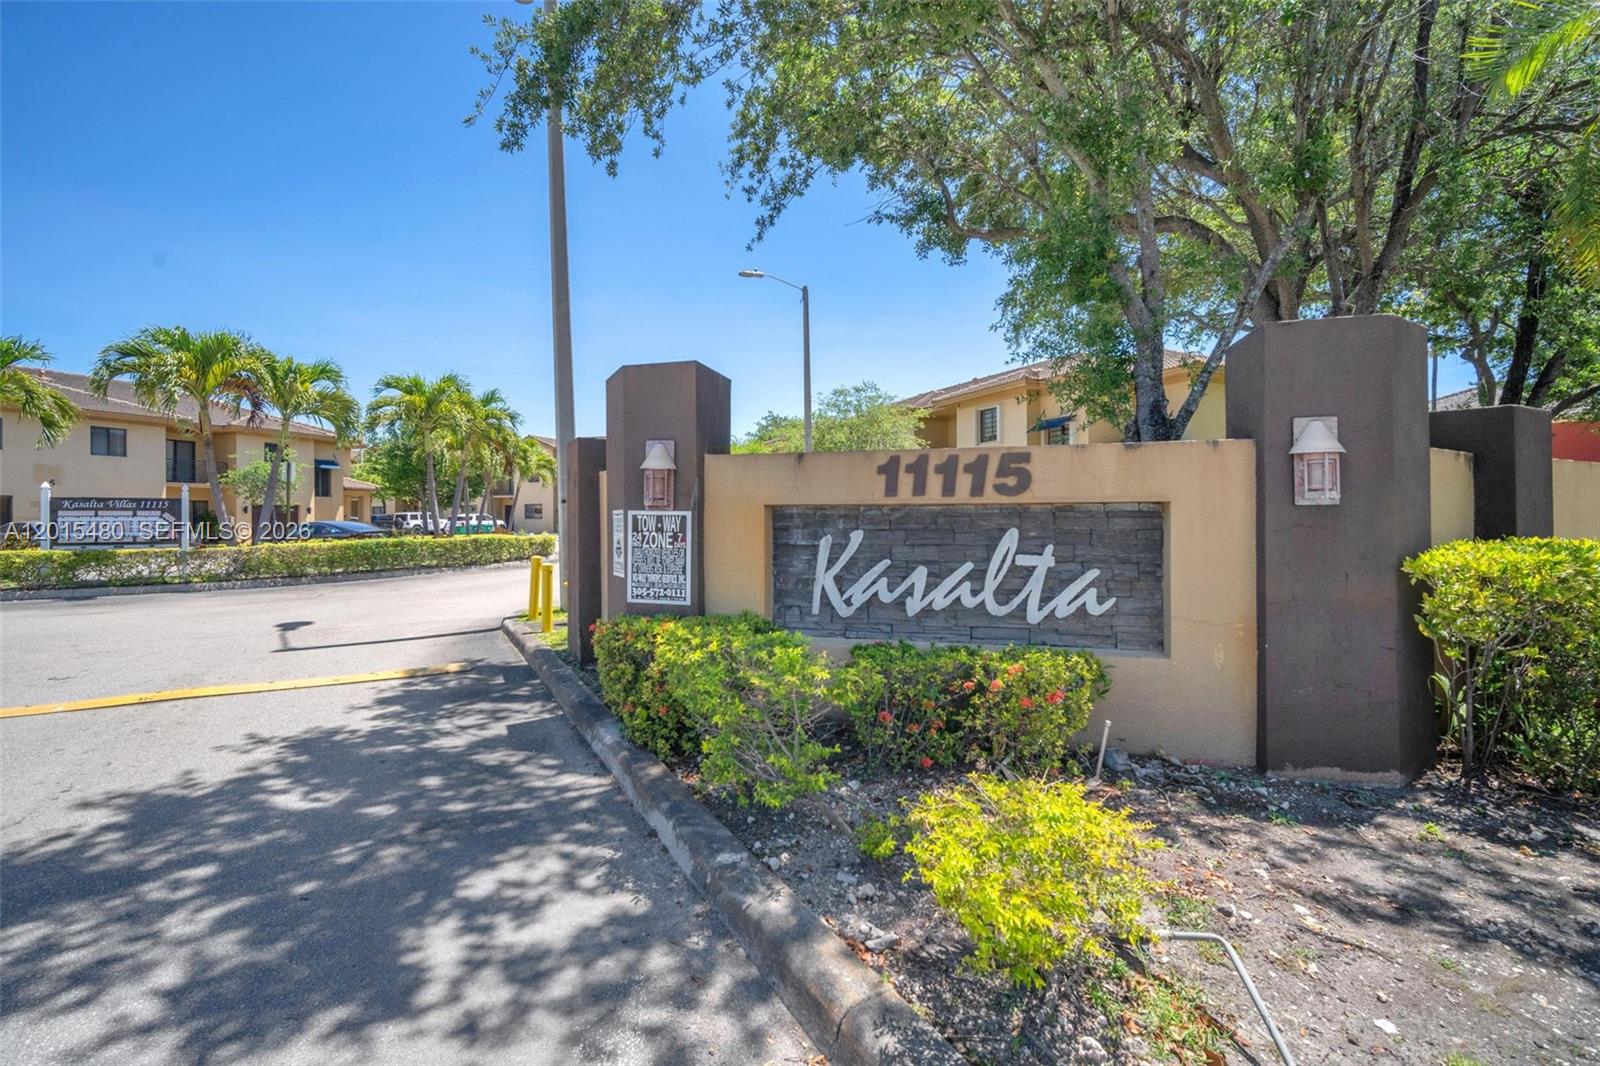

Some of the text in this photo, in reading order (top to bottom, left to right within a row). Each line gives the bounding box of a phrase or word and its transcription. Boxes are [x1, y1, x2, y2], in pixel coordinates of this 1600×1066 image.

[877, 451, 1032, 497] 11115
[62, 499, 169, 509] Kasalta Villas 11115
[637, 515, 682, 531] TOW WAY
[632, 532, 683, 548] 24 ZONE 7
[811, 527, 1118, 624] Kasalta
[632, 587, 686, 597] 305-572-0111
